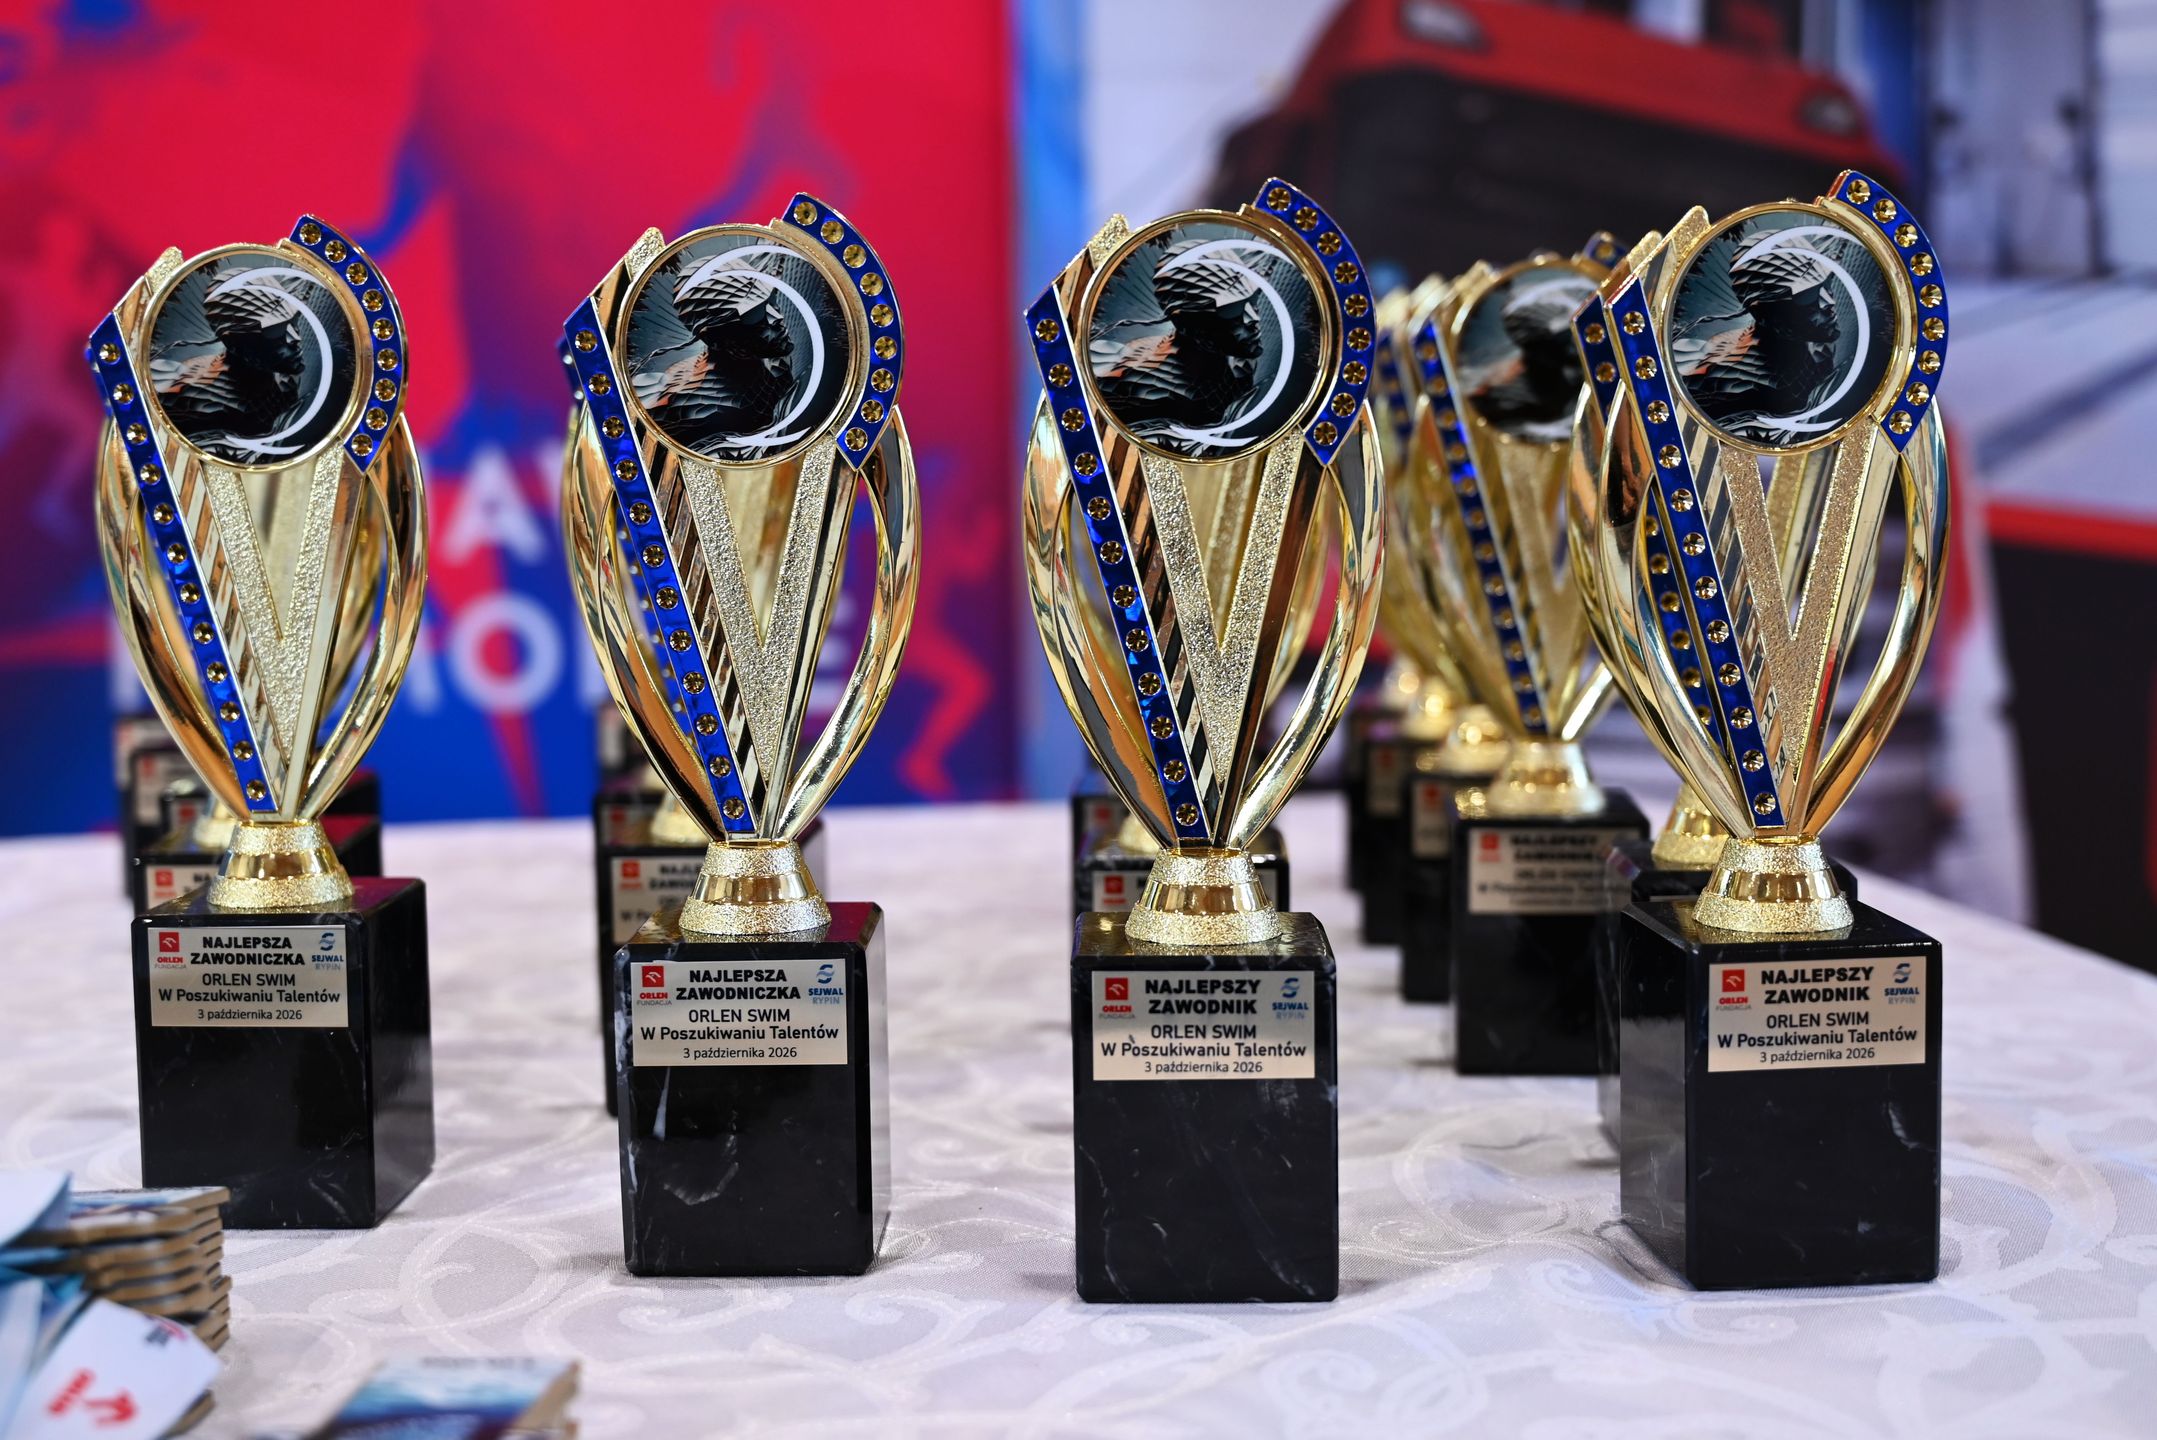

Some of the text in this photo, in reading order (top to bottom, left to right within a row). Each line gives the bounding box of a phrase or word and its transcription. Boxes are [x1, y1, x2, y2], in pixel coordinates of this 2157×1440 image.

[203, 937, 292, 949] NAJLEPSZA
[190, 953, 305, 966] ZAWODNICZKA
[312, 955, 343, 963] SEJWAL
[202, 974, 295, 986] ORLEN SWIM
[690, 970, 786, 982] NAJLEPSZA
[1761, 966, 1874, 984] NAJLEPSZY
[676, 987, 801, 1000] ZAWODNICZKA
[808, 988, 843, 996] SEJWAL
[1145, 980, 1261, 994] NAJLEPSZY
[1885, 988, 1919, 996] SEJWAL
[159, 989, 340, 1003] W Poszukiwaniu Talentów
[1719, 997, 1748, 1005] ORLEN
[1765, 987, 1870, 1004] ZAWODNIK
[1149, 1000, 1257, 1014] ZAWODNIK
[1272, 1003, 1308, 1011] SEJWAL
[198, 1009, 302, 1020] 3 października 2026
[689, 1009, 790, 1022] ORLEN SWIM
[1767, 1012, 1869, 1029] ORLEN SWIM
[641, 1024, 839, 1040] W Poszukiwaniu Talentów
[1151, 1025, 1256, 1038] ORLEN SWIM
[1718, 1026, 1916, 1048] W Poszukiwaniu Talentów
[683, 1048, 796, 1059] 3 października 2026
[1101, 1041, 1306, 1056] W Poszukiwaniu Talentów
[1760, 1048, 1874, 1064] 3 października 2026
[1145, 1062, 1262, 1074] 3 października 2026
